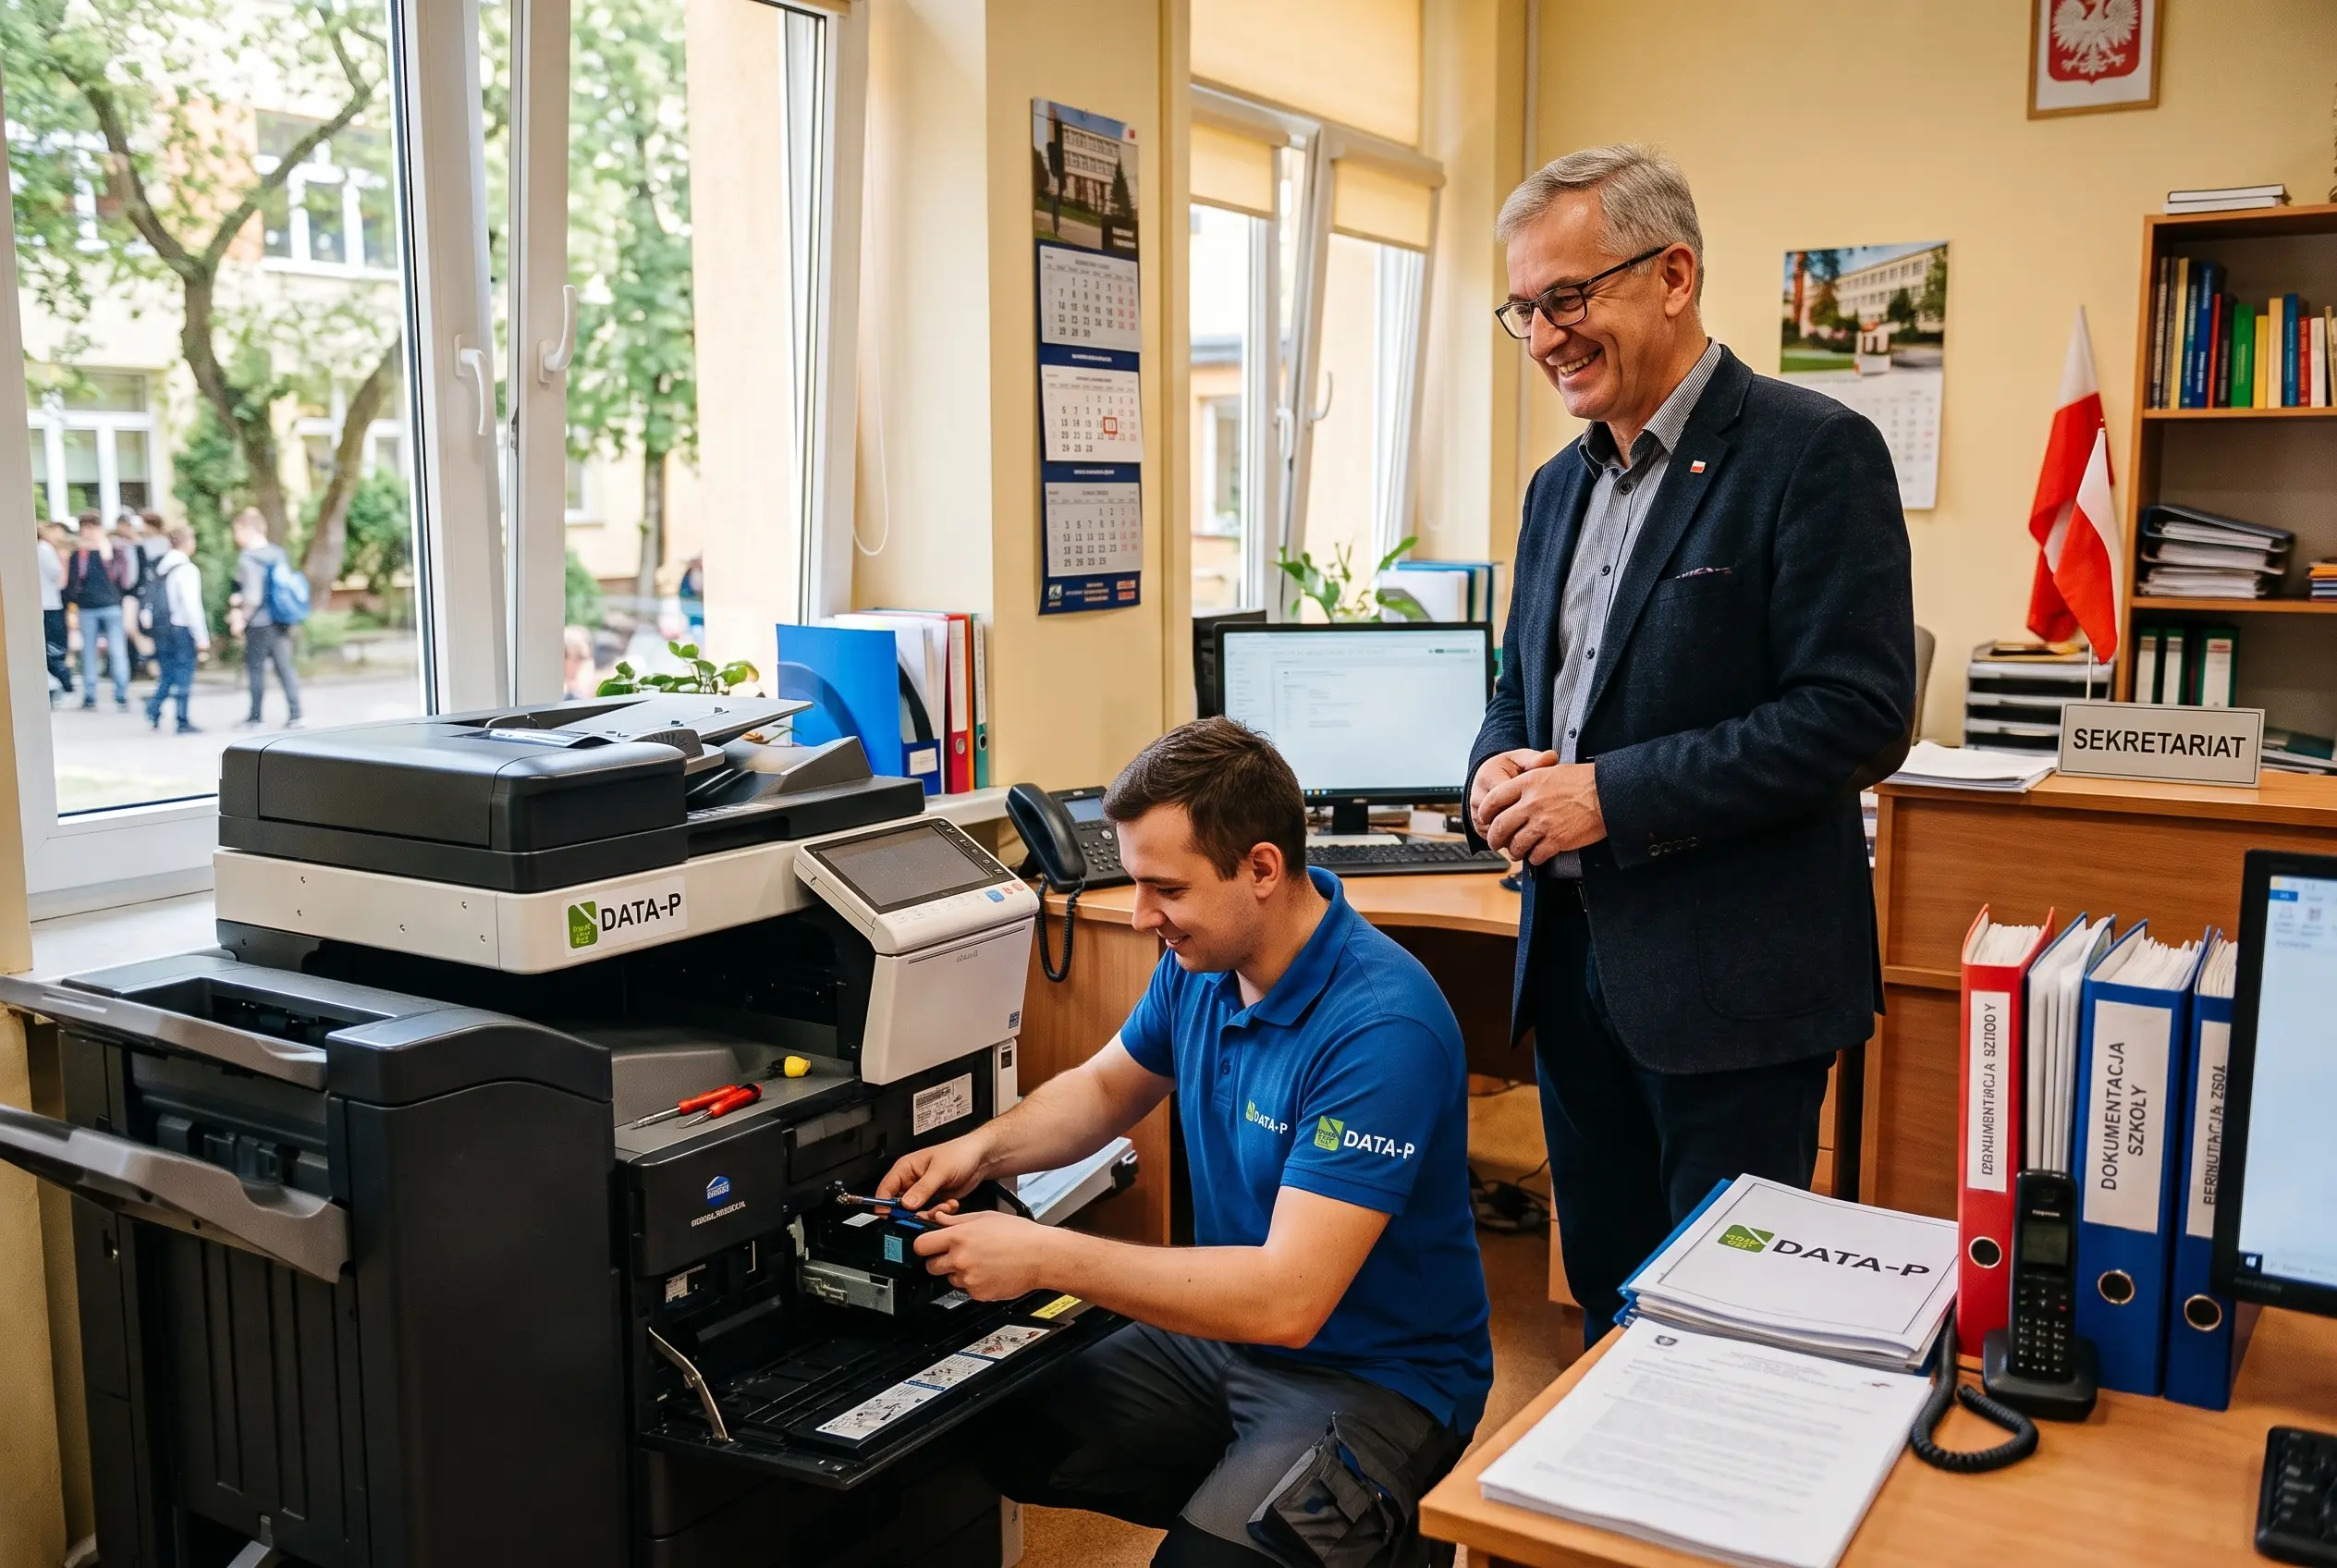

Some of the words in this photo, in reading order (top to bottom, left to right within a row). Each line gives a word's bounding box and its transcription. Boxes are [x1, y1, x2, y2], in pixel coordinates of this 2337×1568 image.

[2073, 728, 2246, 758] SEKRETARIAT
[600, 892, 682, 932] DATA-P
[2100, 1042, 2125, 1191] DOKUMENTACJA
[2127, 1084, 2147, 1157] SZKOŁY
[1342, 1129, 1415, 1160] DATA-P
[1772, 1239, 1930, 1277] DATA-P
